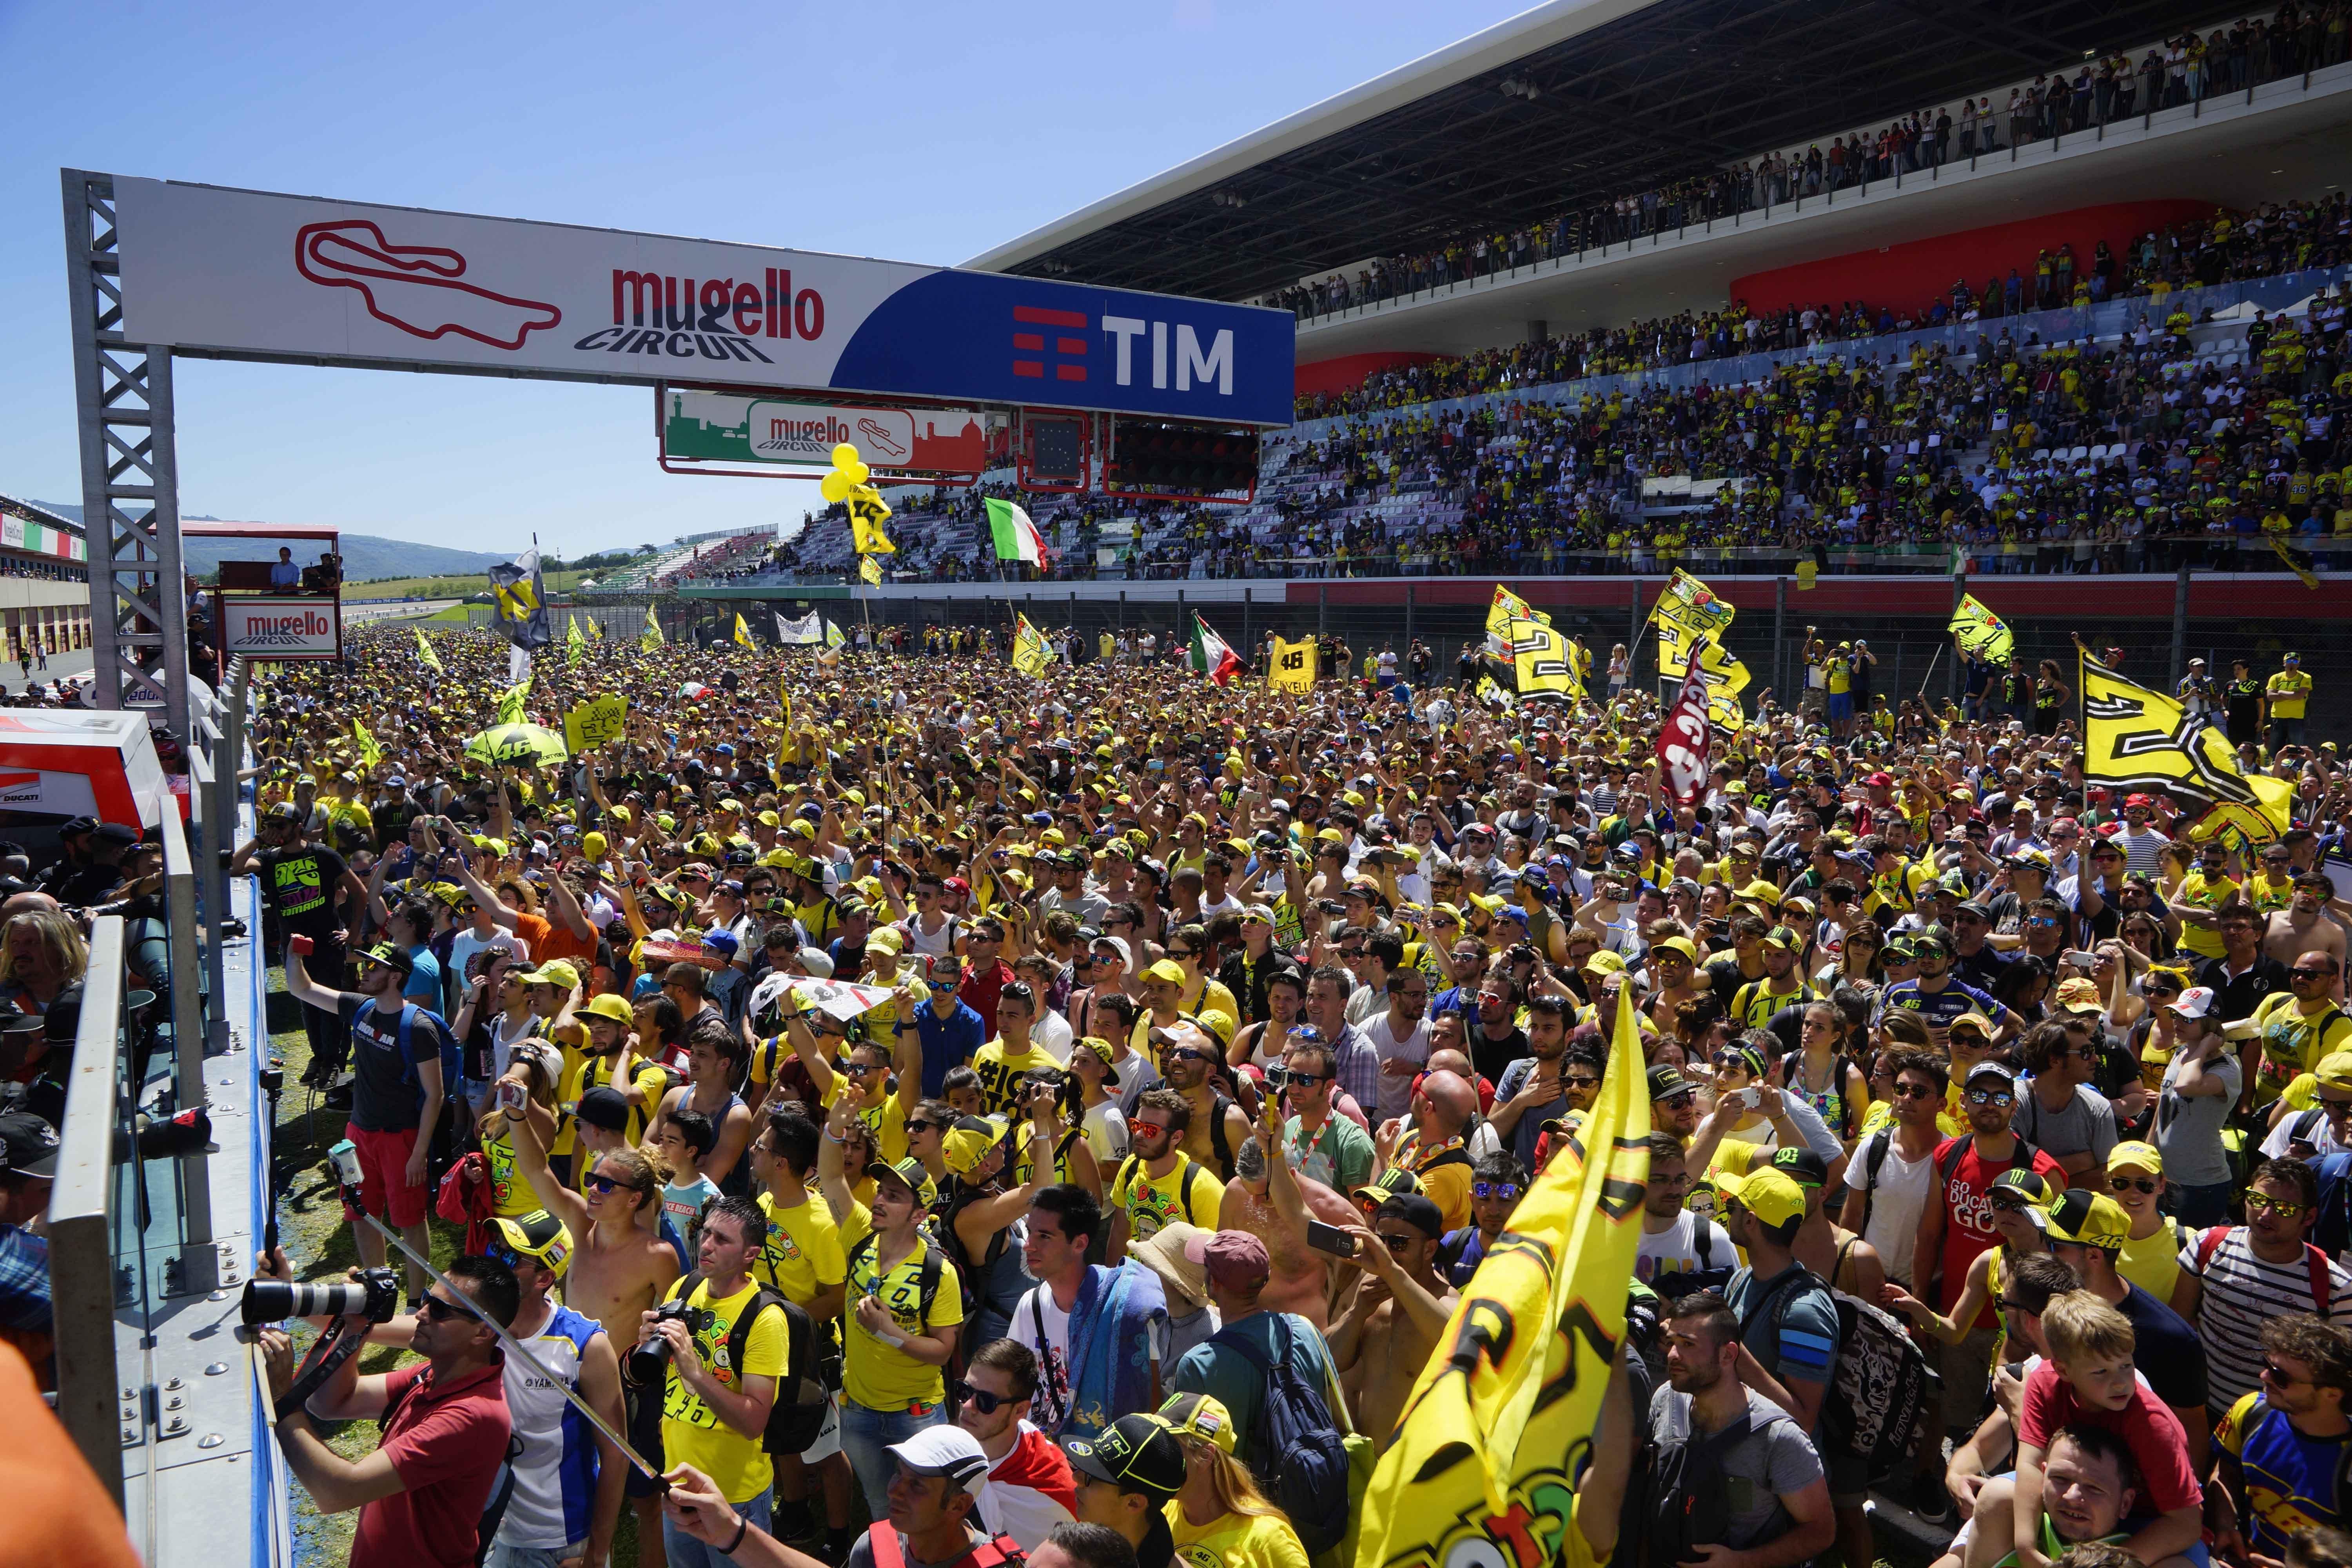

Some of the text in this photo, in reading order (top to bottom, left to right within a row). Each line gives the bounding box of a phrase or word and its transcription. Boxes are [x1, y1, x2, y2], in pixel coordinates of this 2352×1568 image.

[613, 267, 824, 341] mugello
[574, 328, 775, 364] CIRCUIT
[1102, 316, 1233, 395] TIM
[771, 416, 849, 443] mugello
[757, 439, 831, 453] CIRCUIT
[2292, 485, 2306, 494] 46
[1494, 592, 1520, 613] THE
[1693, 592, 1731, 624] DOC
[1963, 600, 1987, 620] THE
[247, 612, 328, 635] mugello
[234, 636, 309, 645] CIRCUIT
[1281, 650, 1303, 670] 46
[2278, 681, 2300, 691] 46
[495, 739, 532, 761] 46
[1526, 878, 1542, 888] YAMAHA
[1274, 925, 1303, 944] THE
[868, 1000, 897, 1019] 46
[1747, 993, 1802, 1029] 46
[1900, 999, 1922, 1009] 46
[1105, 1087, 1123, 1095] KTM
[969, 1144, 988, 1170] 46
[1950, 1179, 1970, 1192] GO
[675, 1203, 696, 1215] BEACH
[1953, 1204, 1996, 1234] GO
[2090, 1234, 2124, 1249] 46
[662, 1378, 719, 1429] 46
[1195, 1551, 1211, 1562] 46
